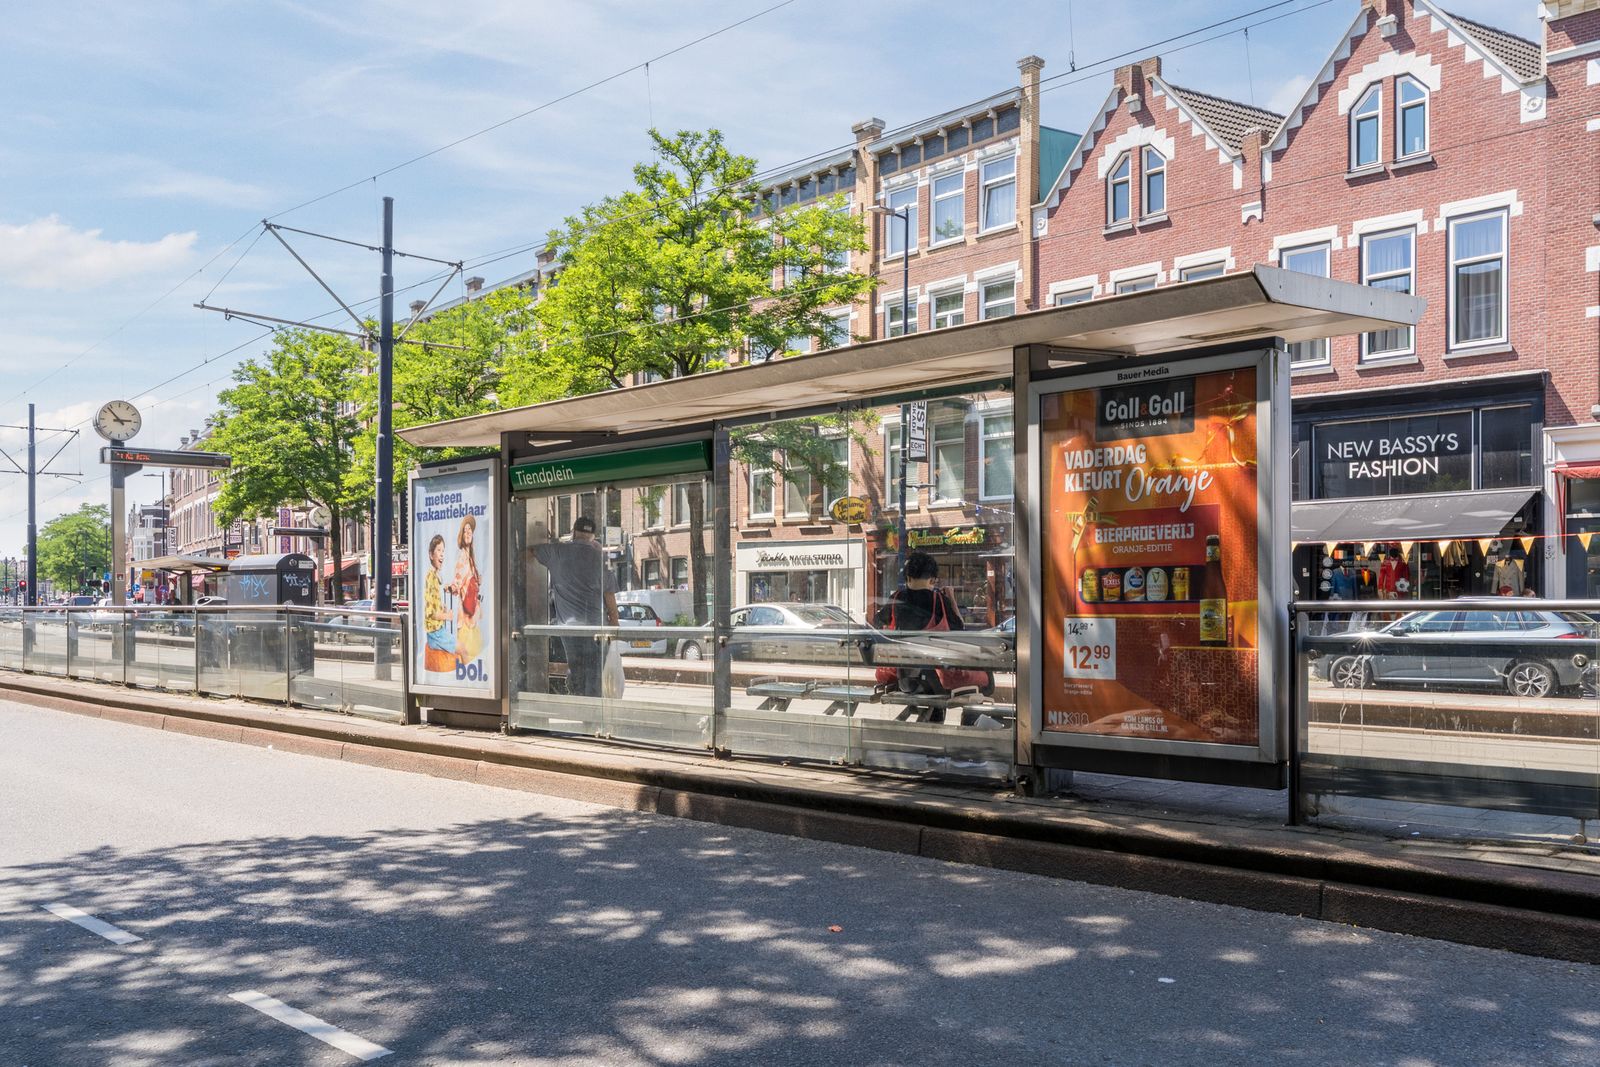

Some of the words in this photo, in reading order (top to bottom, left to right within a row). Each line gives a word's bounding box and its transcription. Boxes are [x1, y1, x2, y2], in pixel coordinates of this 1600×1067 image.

[1117, 372, 1141, 381] Bauer
[1143, 367, 1170, 377] Media
[916, 400, 926, 435] EST
[1149, 418, 1168, 427] 1884
[911, 441, 926, 450] ECHT
[1327, 440, 1373, 460] NEW
[1379, 433, 1459, 456] BASSY'S
[1064, 444, 1147, 470] VADERDAG
[515, 464, 575, 486] Tiendplein
[1349, 457, 1439, 479] FASHION
[425, 492, 462, 507] meteen
[1064, 469, 1122, 493] KLEURT
[1125, 466, 1214, 513] Oranje
[416, 503, 486, 522] vakantieklaar
[1095, 523, 1195, 544] BIERPROEVERIJ
[789, 553, 841, 561] NAGELSTUDIO
[1112, 543, 1173, 554] ORANJE-EDITIE
[1069, 645, 1111, 670] 12.99
[455, 658, 488, 682] bol.
